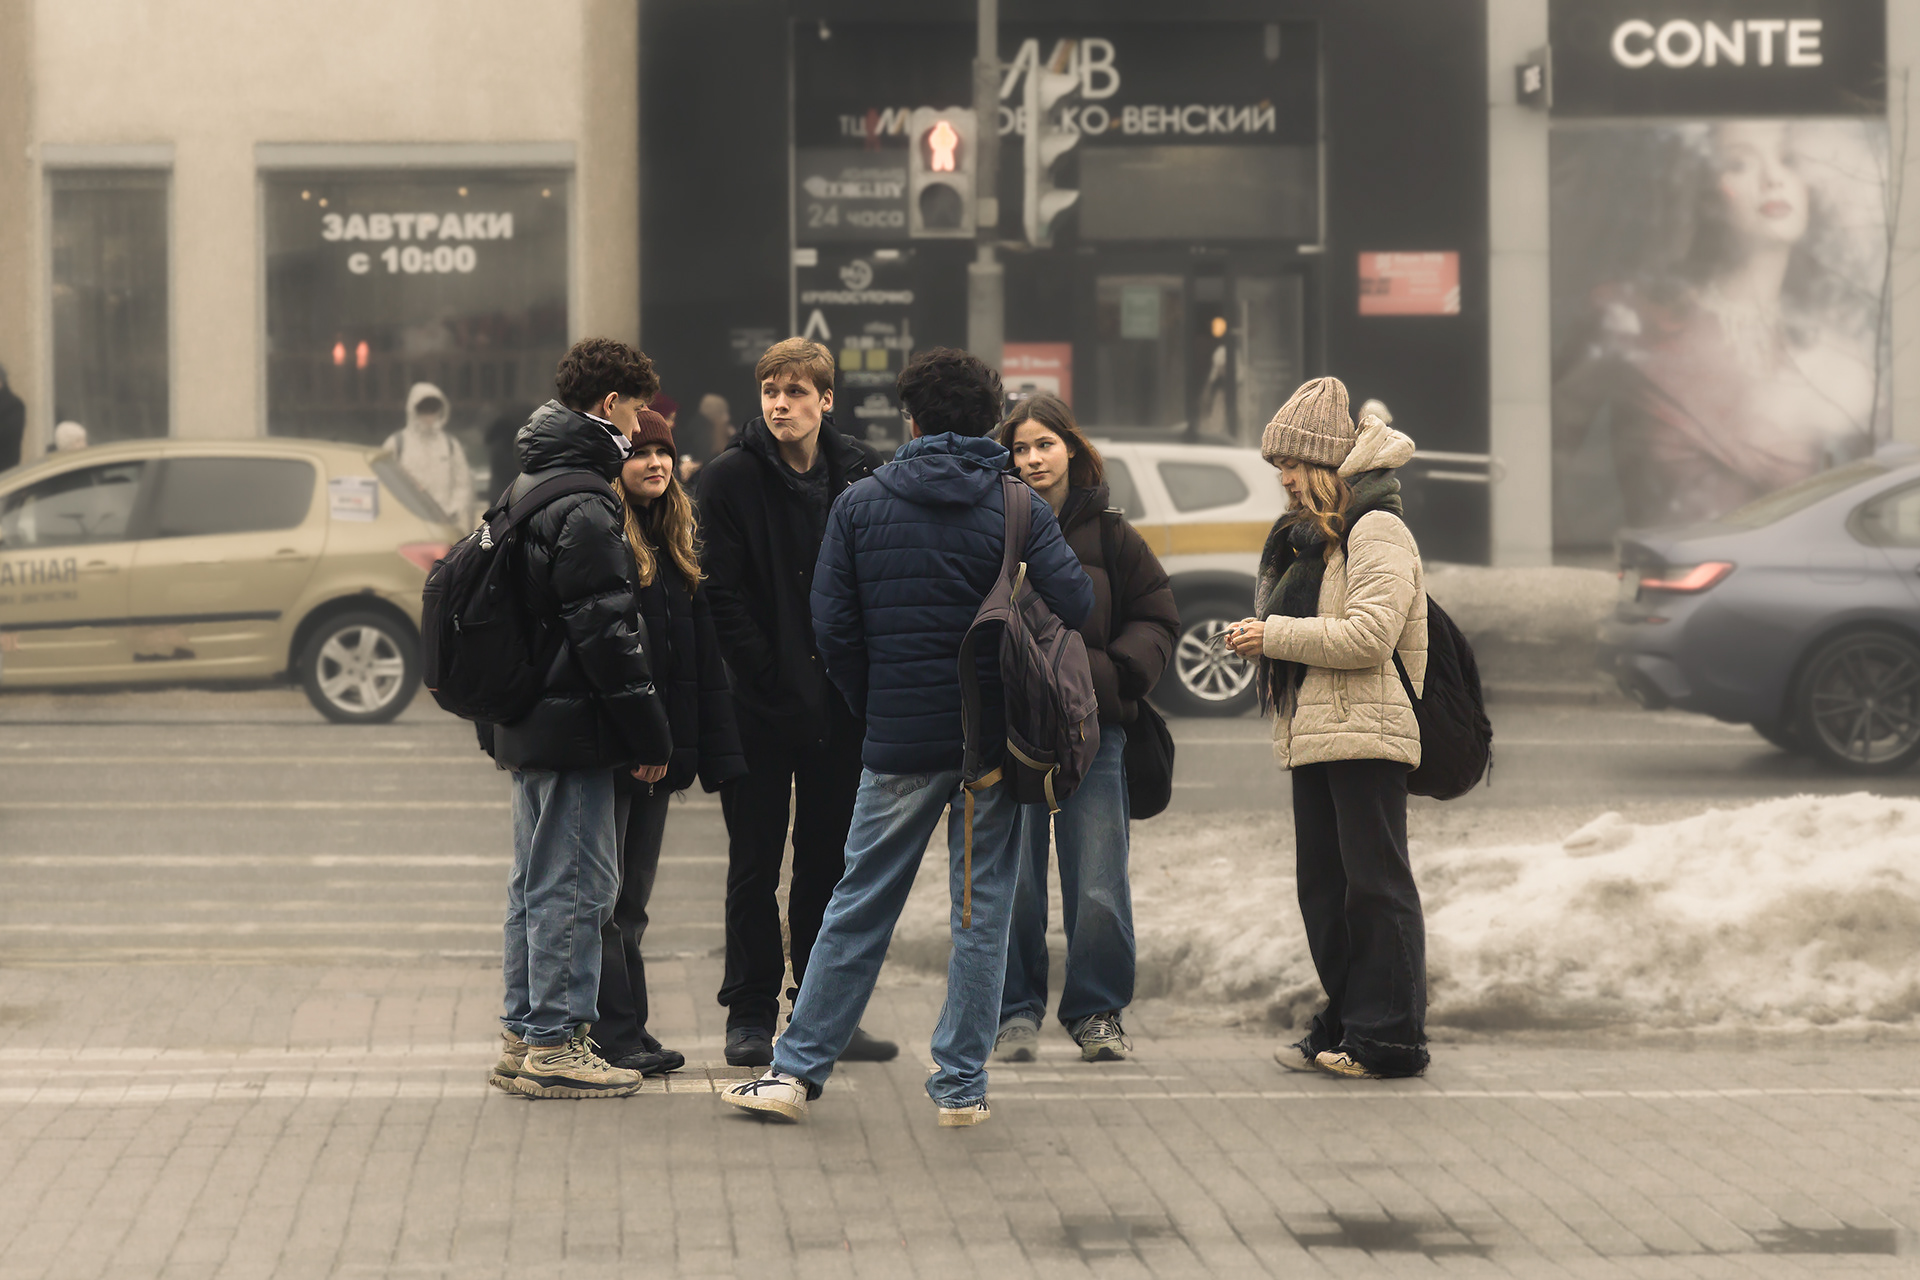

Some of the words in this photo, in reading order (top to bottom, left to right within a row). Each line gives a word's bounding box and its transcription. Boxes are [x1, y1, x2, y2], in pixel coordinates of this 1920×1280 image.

[1611, 18, 1823, 68] CONTE
[322, 212, 514, 241] ЗАВТРАКИ
[807, 203, 839, 228] 24
[846, 210, 905, 228] часа
[347, 252, 370, 275] с
[381, 245, 477, 274] 10:00
